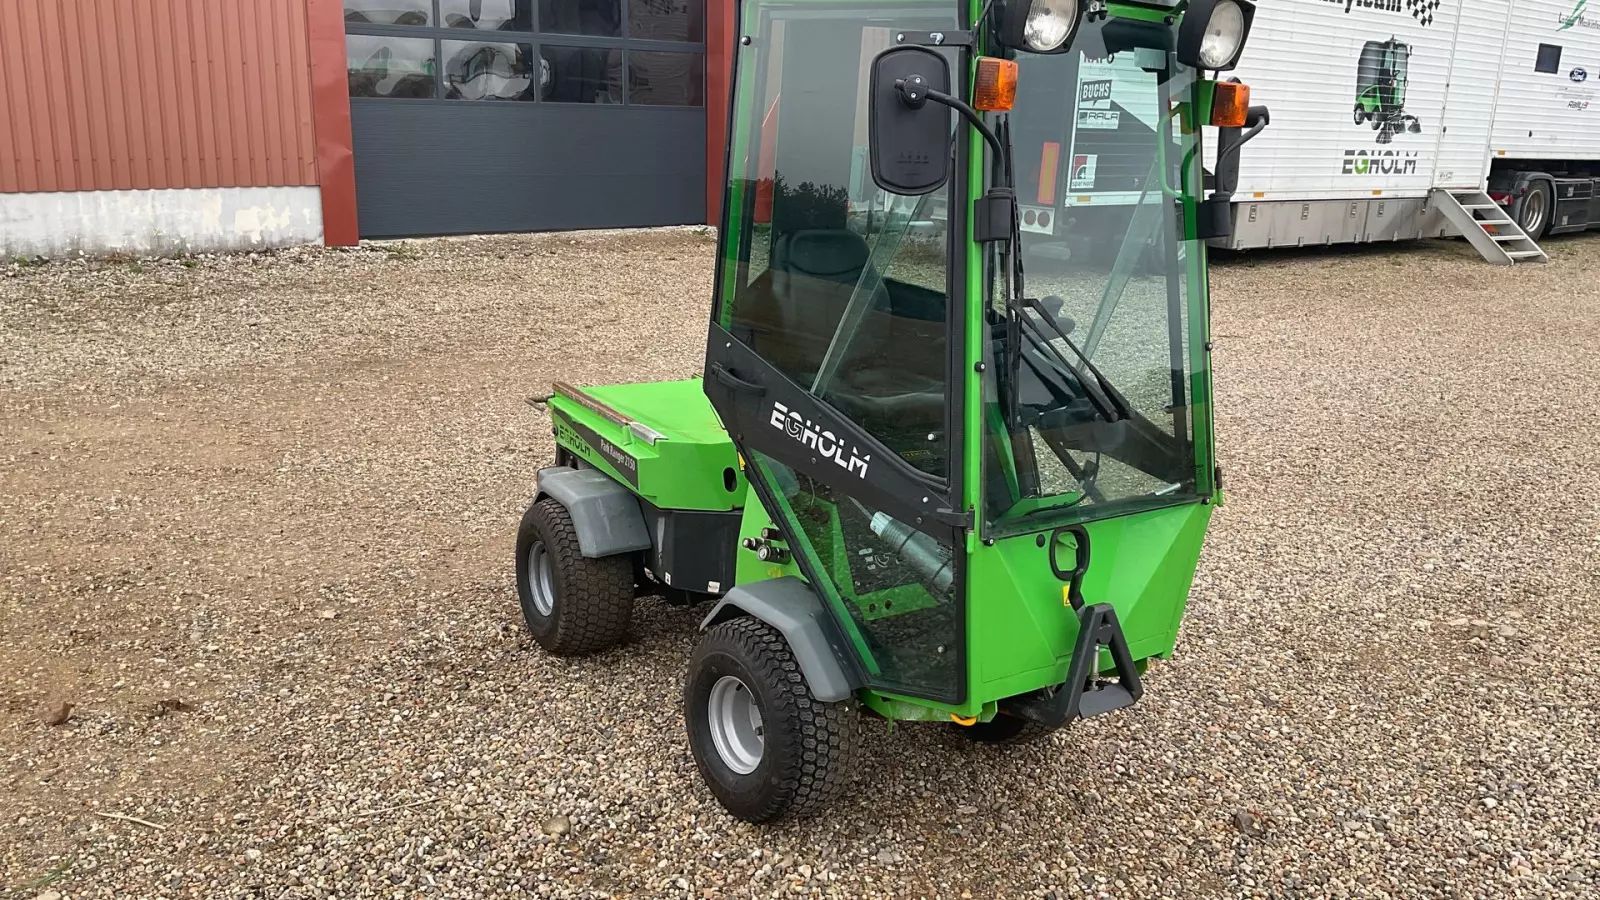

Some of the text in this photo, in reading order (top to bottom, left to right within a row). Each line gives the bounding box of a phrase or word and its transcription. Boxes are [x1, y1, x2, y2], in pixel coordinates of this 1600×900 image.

[1082, 83, 1110, 98] BUCHS
[1341, 149, 1418, 175] EGHOLM
[559, 424, 591, 457] EGHOLM
[769, 400, 871, 480] EGHOLM
